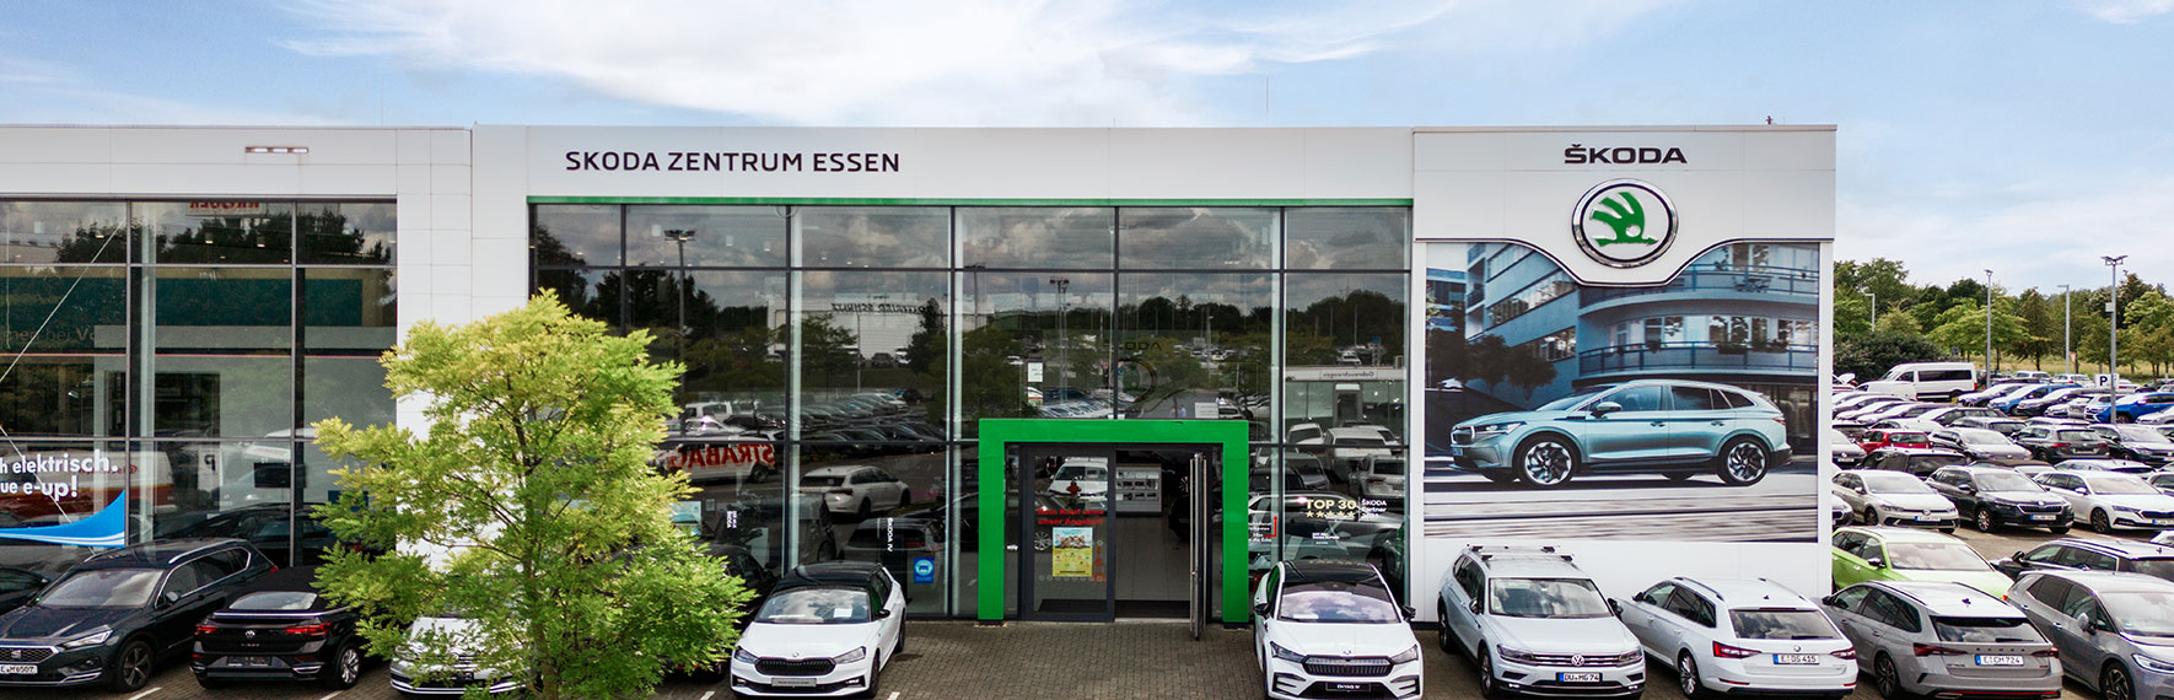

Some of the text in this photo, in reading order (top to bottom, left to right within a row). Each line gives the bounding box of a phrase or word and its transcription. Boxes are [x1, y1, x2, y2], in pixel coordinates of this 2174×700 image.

[565, 151, 900, 172] SKODA ZENTRUM ESSEN
[1564, 144, 1688, 164] ŠKODA
[2099, 375, 2108, 386] P
[12, 449, 119, 473] elektrisch.
[23, 475, 78, 502] e-up!
[1306, 499, 1357, 510] TOP 30
